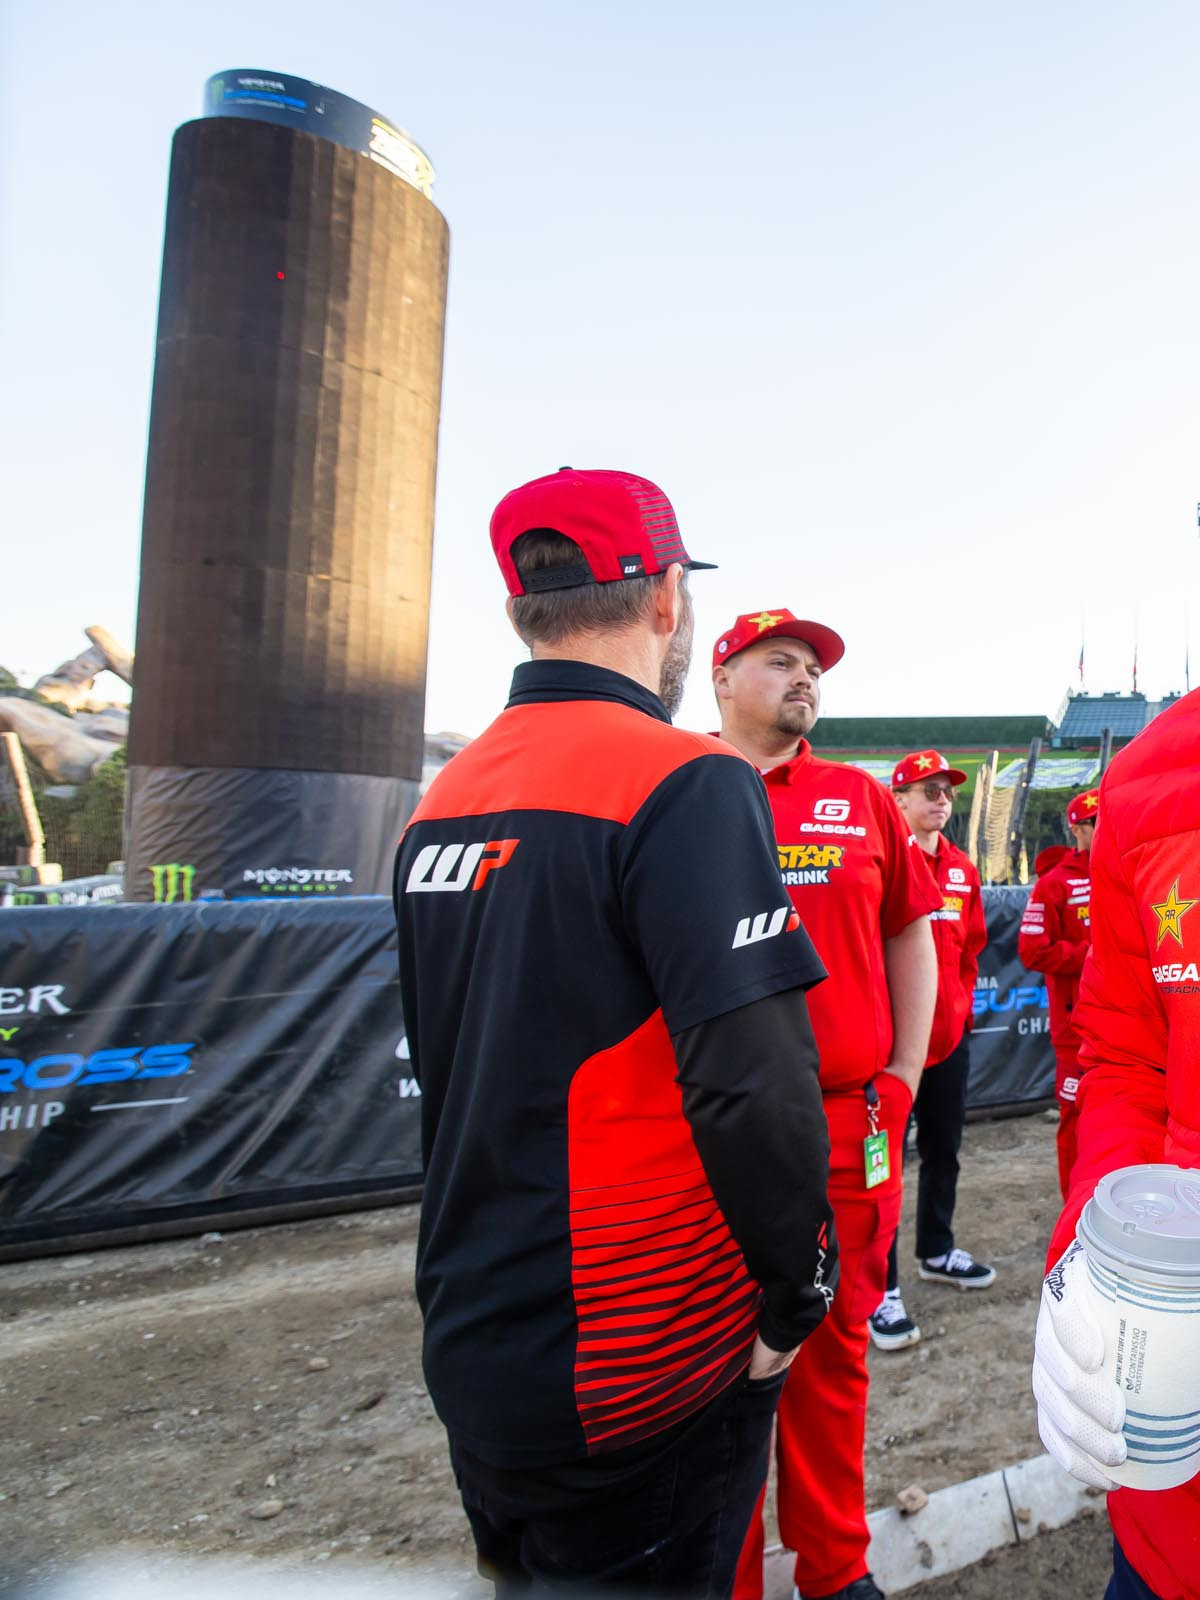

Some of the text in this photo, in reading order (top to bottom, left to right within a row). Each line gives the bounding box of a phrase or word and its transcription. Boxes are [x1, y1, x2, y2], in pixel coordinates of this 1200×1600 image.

[800, 823, 867, 837] GASGAS
[242, 867, 353, 885] MONSTER
[405, 839, 520, 893] WP
[1129, 1327, 1141, 1378] CONTAINS NO
[1134, 1352, 1145, 1394] POLYSTYRENE
